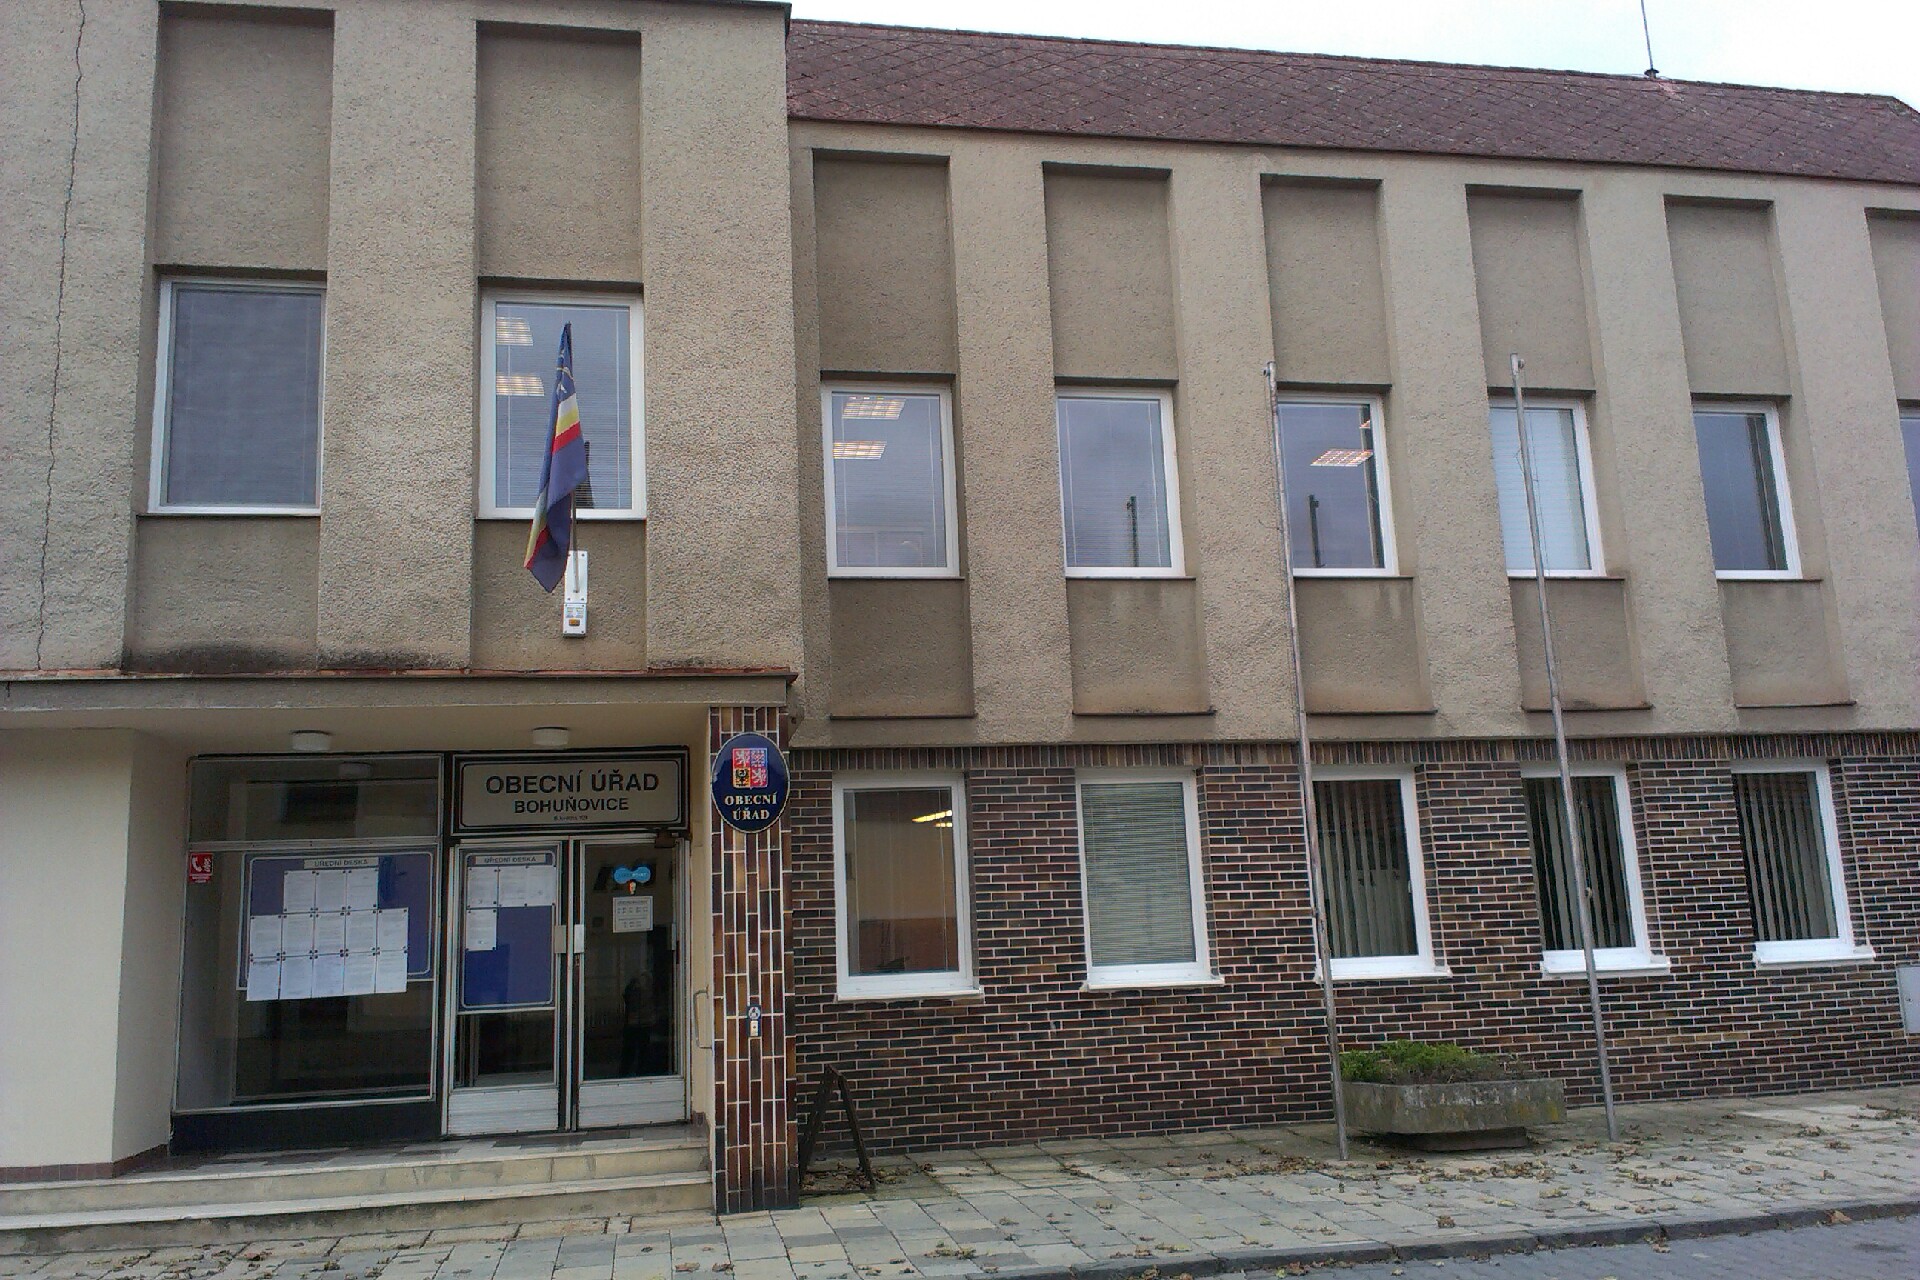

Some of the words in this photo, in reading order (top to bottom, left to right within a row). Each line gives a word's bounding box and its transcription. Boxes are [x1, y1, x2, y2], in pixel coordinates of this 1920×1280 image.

[485, 769, 584, 794] OBECNÍ
[591, 768, 660, 792] ÚŘAD
[514, 795, 630, 814] BOHUŇOVICE
[724, 791, 778, 806] OBECNÍ
[732, 806, 770, 821] ÚŘAD
